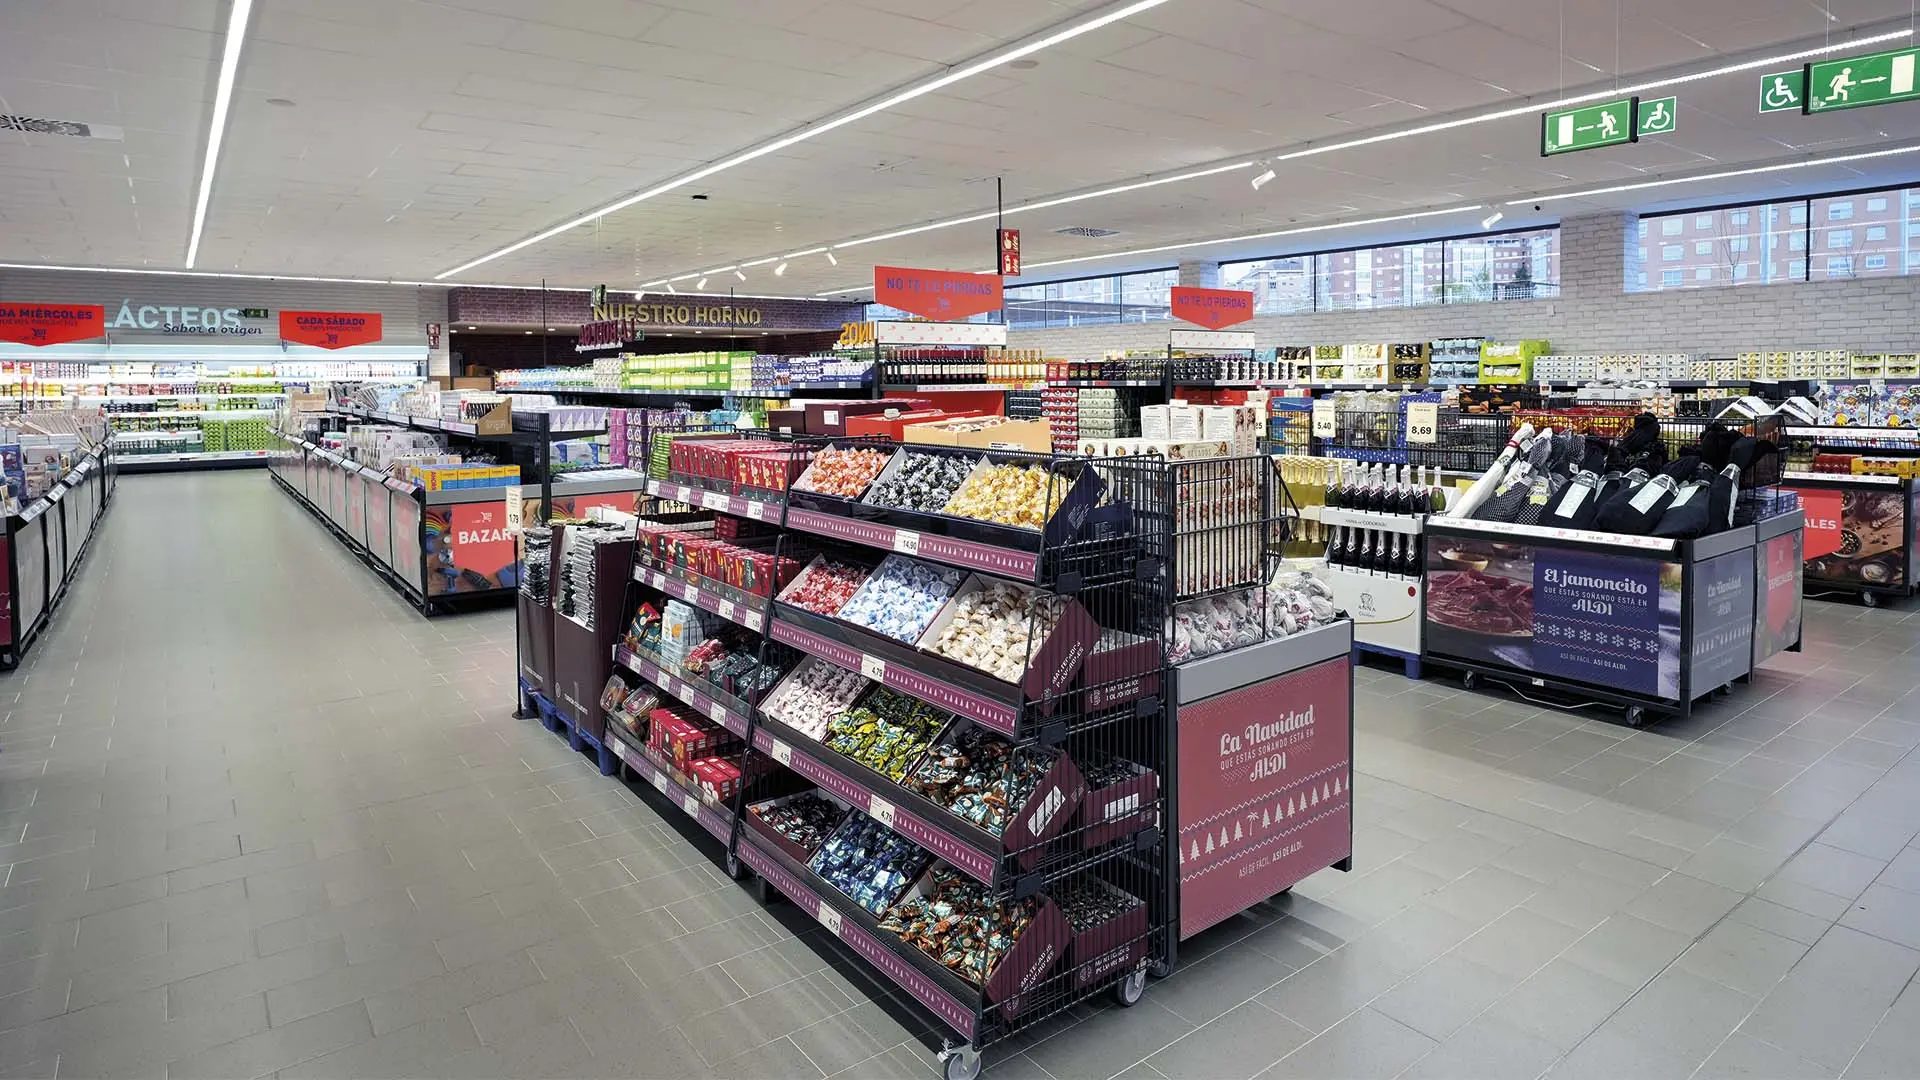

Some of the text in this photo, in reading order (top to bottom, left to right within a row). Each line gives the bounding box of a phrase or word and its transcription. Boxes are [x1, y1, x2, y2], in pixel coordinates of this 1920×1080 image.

[887, 278, 904, 290] NO
[0, 308, 16, 318] DA
[593, 303, 688, 323] NUESTRO
[696, 308, 761, 325] HORNO
[297, 317, 323, 325] CADA
[163, 323, 263, 336] Sabor a origen
[1317, 421, 1331, 430] 5,40
[1411, 426, 1432, 435] 8,69
[458, 528, 513, 545] BAZAR
[1544, 568, 1648, 595] El jamoncito
[1543, 586, 1556, 594] QUE
[1571, 598, 1613, 616] ALDI
[1220, 704, 1316, 757] La Navidad
[1220, 758, 1234, 770] QUE
[1249, 752, 1287, 783] ALDI
